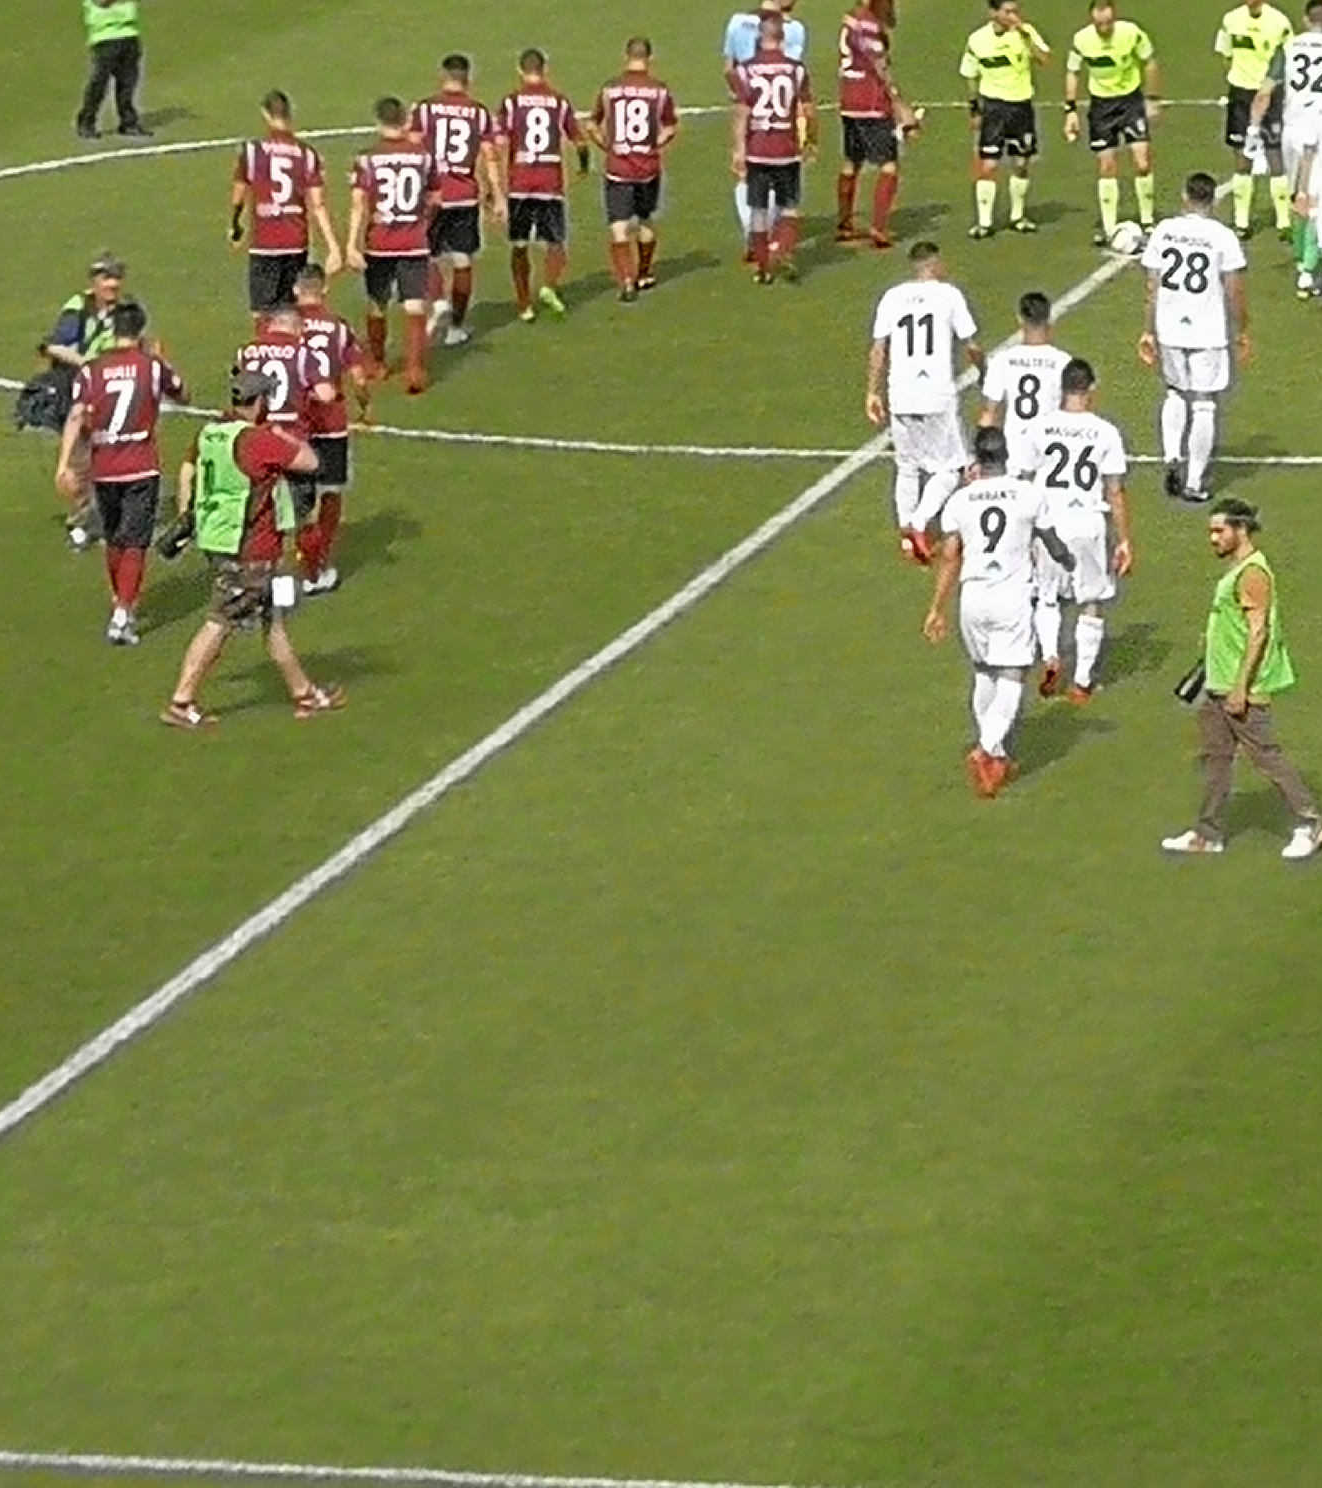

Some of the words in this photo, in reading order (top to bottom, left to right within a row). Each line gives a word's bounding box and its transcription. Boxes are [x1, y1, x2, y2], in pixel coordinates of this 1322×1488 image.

[750, 74, 794, 118] 20
[434, 118, 470, 163] 13
[526, 107, 550, 153] 8
[613, 99, 650, 142] 18
[270, 157, 293, 203] 5
[377, 167, 421, 213] 30
[1160, 247, 1211, 294] 28
[897, 313, 935, 357] 11
[104, 380, 136, 435] 7
[1014, 373, 1041, 420] 8
[1044, 442, 1099, 491] 26
[979, 505, 1008, 553] 9
